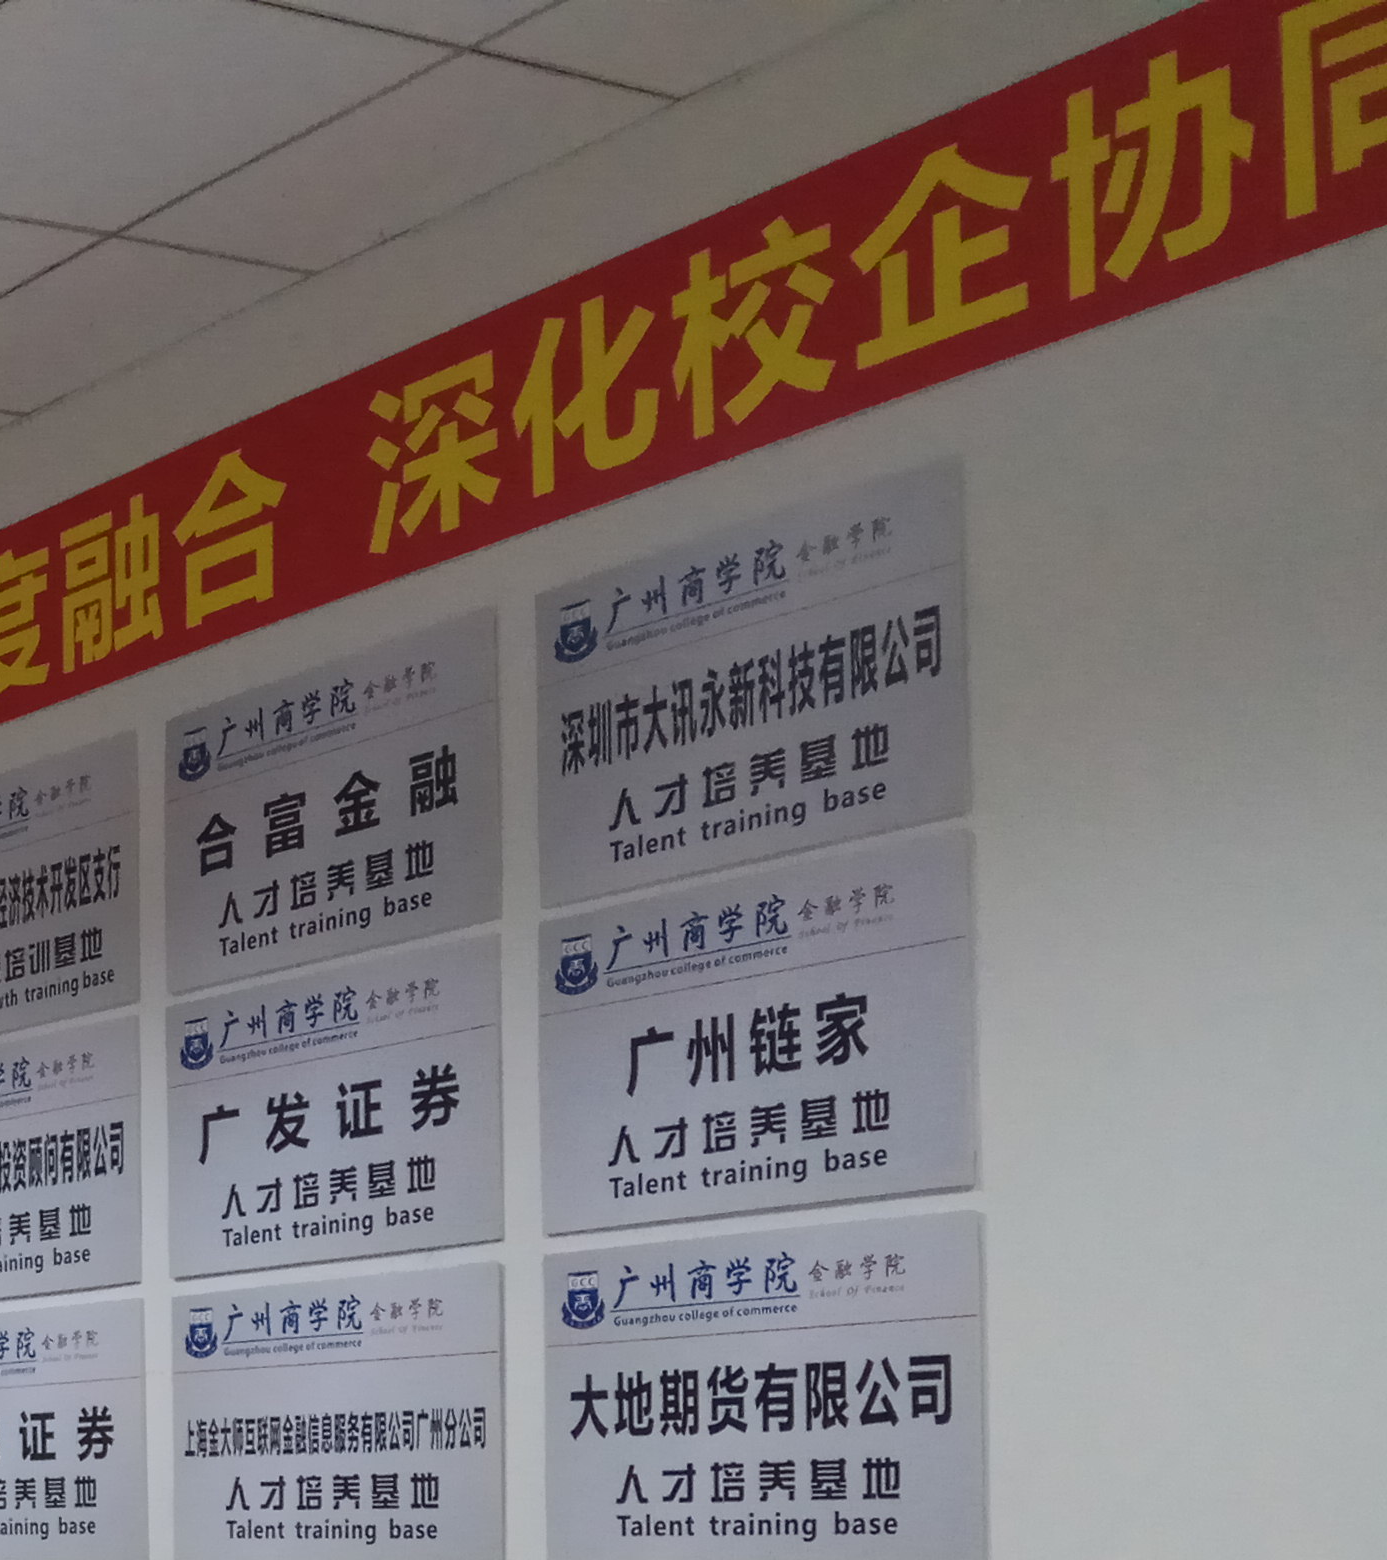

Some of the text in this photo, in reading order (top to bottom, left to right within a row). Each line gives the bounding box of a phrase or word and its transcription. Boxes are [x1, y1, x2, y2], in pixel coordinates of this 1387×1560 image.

[606, 539, 787, 635] 广州商学院
[218, 678, 356, 757] 广州商学院
[561, 604, 942, 776] 深圳市大讯永新科技有限公司
[609, 724, 890, 831] 人才培养基地
[196, 744, 459, 877] 合富金融
[610, 780, 888, 863] Talent training base
[218, 840, 434, 928] 人才培养基地
[219, 890, 433, 956] Talent training base
[606, 894, 788, 971] 广州商学院
[24, 976, 78, 1003] training
[83, 967, 115, 990] base
[219, 986, 359, 1049] 广州商学院
[626, 992, 870, 1097] 广州链家
[198, 1063, 460, 1165] 广发证券
[608, 1088, 891, 1166] 人才培养基地
[221, 1155, 436, 1219] 人才培养基地
[610, 1149, 888, 1199] Talent training base
[53, 1246, 91, 1266] base
[222, 1205, 435, 1248] Talent training base
[613, 1251, 798, 1309] 广州商学院
[808, 1254, 906, 1281] 金融学院
[223, 1294, 362, 1342] 广州商学院
[613, 1304, 798, 1327] Guangzhou college of commerce
[570, 1353, 952, 1439] 大地期货有限公司
[226, 1472, 439, 1511] 人才培养基地
[616, 1457, 901, 1503] 人才培养基地
[59, 1517, 96, 1535] base
[227, 1518, 438, 1545] Talent training base
[617, 1512, 899, 1541] Talent training base
